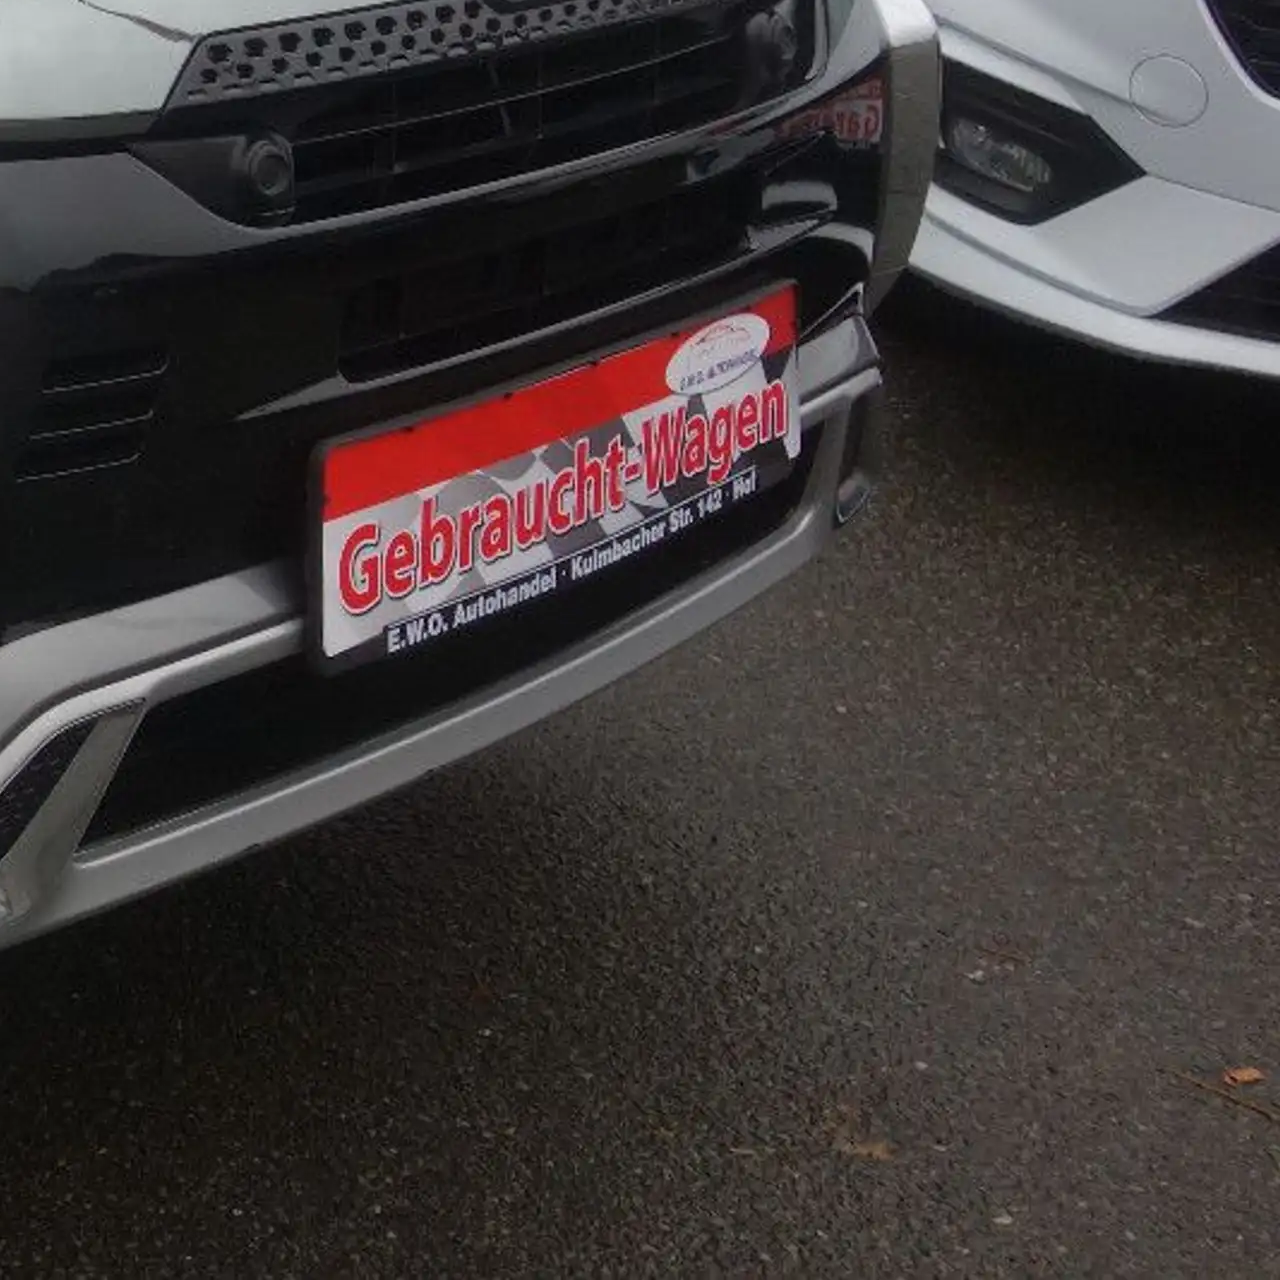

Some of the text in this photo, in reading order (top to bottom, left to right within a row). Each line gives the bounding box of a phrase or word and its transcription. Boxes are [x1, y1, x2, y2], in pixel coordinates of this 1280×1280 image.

[339, 381, 787, 614] Gebraucht-Wagen
[387, 614, 449, 653] E.W.O.
[452, 568, 557, 628] Autohandel
[571, 520, 666, 580] Kulmbacher
[669, 506, 694, 533] Str.
[697, 487, 723, 518] 142
